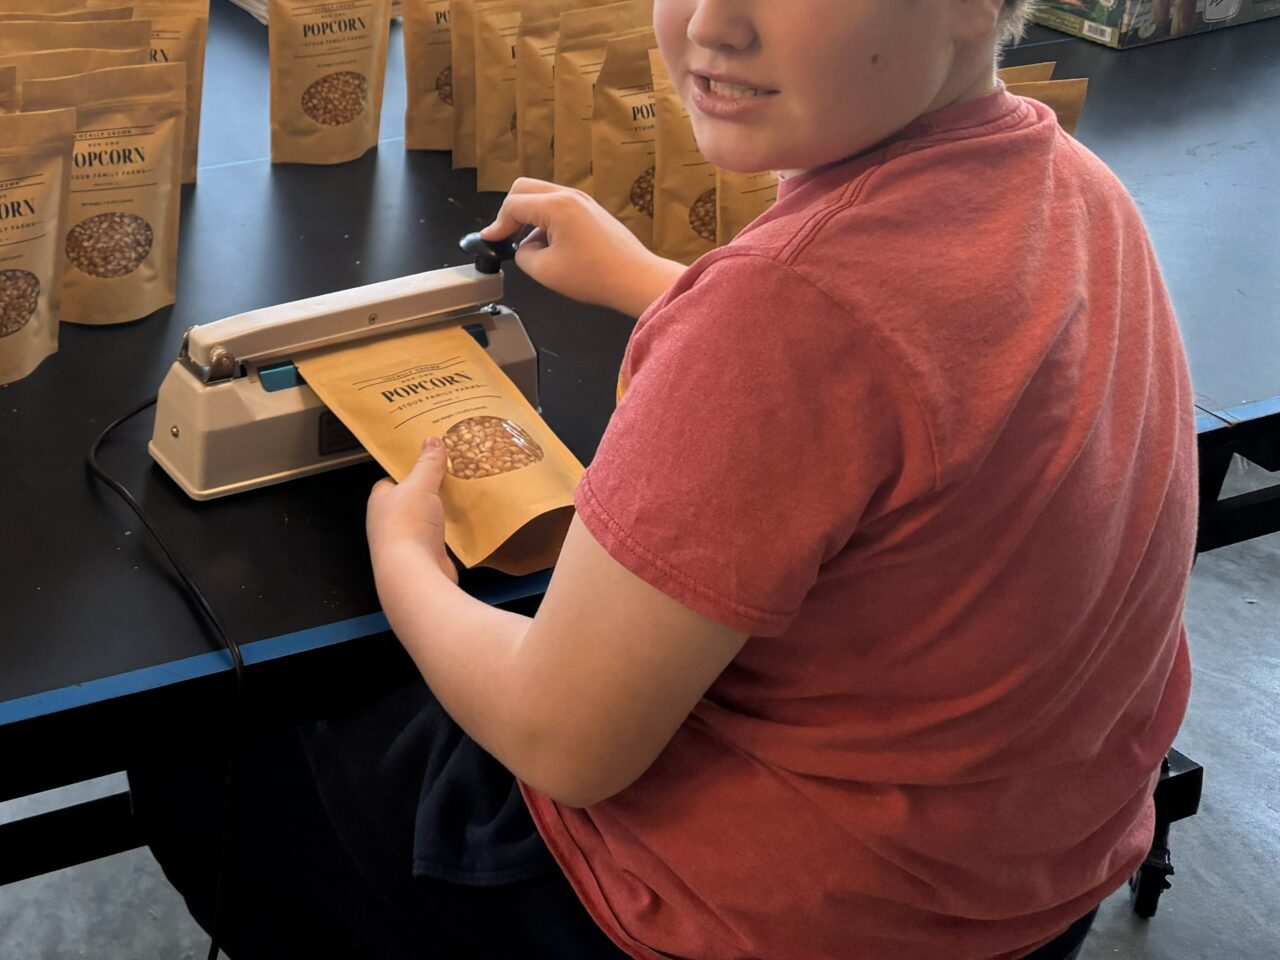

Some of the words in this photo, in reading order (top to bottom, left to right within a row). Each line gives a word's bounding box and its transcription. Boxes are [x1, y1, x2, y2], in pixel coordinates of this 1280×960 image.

[303, 16, 367, 38] POPCORN
[74, 146, 145, 168] OPCORN
[381, 371, 472, 403] POPCORN
